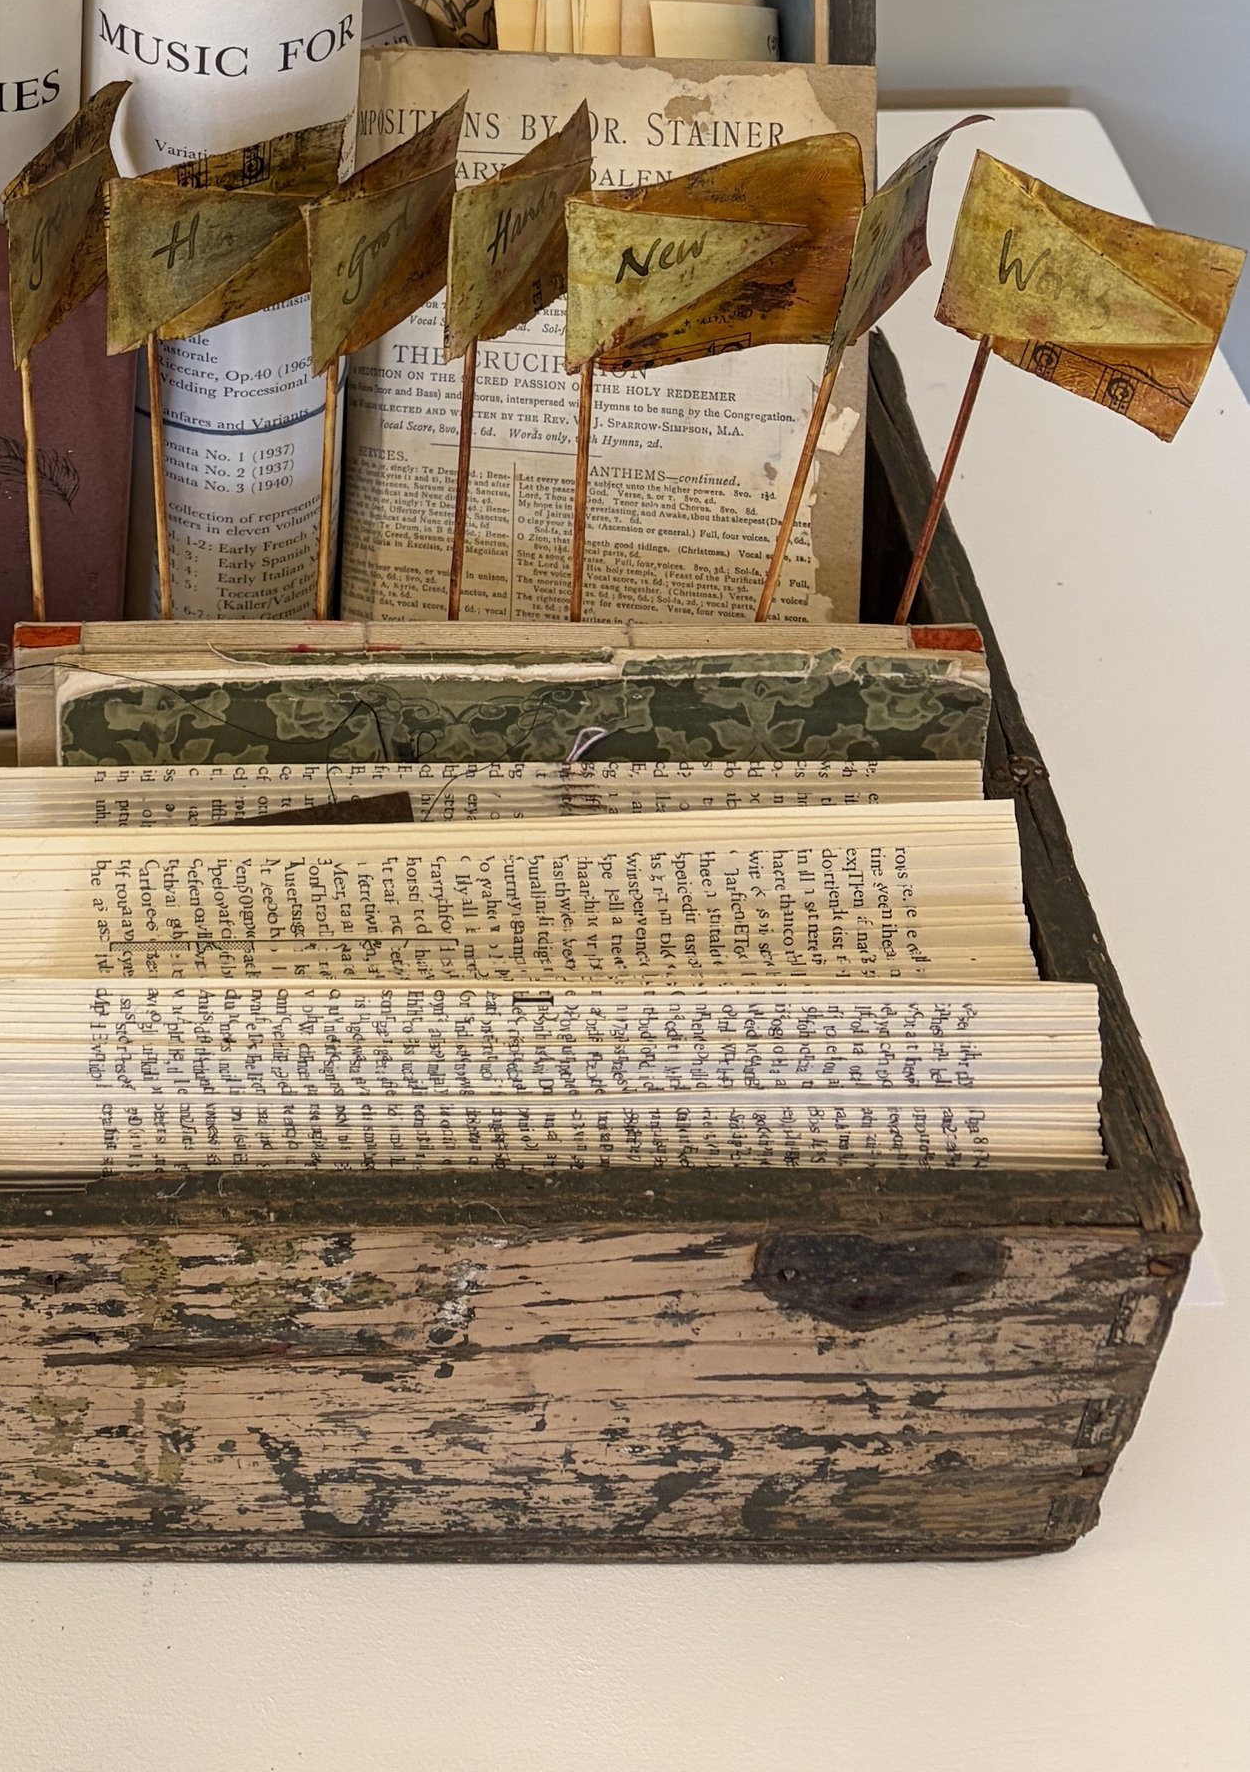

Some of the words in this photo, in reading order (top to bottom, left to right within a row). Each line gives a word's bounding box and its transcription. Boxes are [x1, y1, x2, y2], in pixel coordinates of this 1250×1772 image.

[98, 7, 249, 78] MUSIC
[278, 13, 354, 73] FOR
[359, 108, 500, 140] MPOSITINS
[522, 112, 557, 142] BY
[647, 111, 785, 148] STAINER
[154, 139, 212, 159] Variati
[454, 161, 506, 180] ARY
[486, 188, 559, 266] Hands
[342, 198, 411, 306] Good
[615, 230, 707, 284] New
[410, 315, 437, 327] Vocal
[392, 344, 447, 366] THE
[224, 374, 308, 398] Processional
[225, 368, 271, 385] Op.40
[407, 371, 424, 381] ON
[430, 372, 456, 383] THE
[515, 378, 566, 391] PASSION
[594, 384, 620, 394] THE
[626, 385, 661, 397] HOLY
[667, 388, 736, 402] REDEEMER
[395, 387, 412, 397] and
[416, 387, 441, 400] Bass)
[445, 391, 461, 400] and
[506, 394, 564, 408] interspersed
[594, 401, 630, 416] Hymns
[633, 403, 643, 412] to
[647, 403, 658, 413] be
[661, 407, 684, 418] sung
[688, 407, 701, 418] by
[704, 407, 720, 417] the
[723, 409, 796, 423] Congregation.
[163, 407, 211, 428] anfares
[217, 420, 244, 431] and
[252, 407, 309, 429] Variants
[426, 407, 446, 416] AND
[501, 412, 514, 421] BY
[517, 414, 539, 423] THE
[593, 417, 603, 428] J.
[717, 425, 744, 437] M.A.
[406, 421, 435, 434] Score,
[439, 423, 459, 435] 8vo,
[480, 427, 496, 437] 6d.
[509, 428, 542, 441] Words
[546, 433, 571, 444] only,
[601, 435, 643, 448] Hymns,
[647, 439, 663, 449] 2d.
[163, 441, 199, 457] onata
[205, 448, 231, 462] No.
[252, 443, 295, 463] (1937)
[163, 456, 198, 472] onata
[205, 464, 230, 478] No.
[237, 468, 245, 478] 2
[252, 459, 294, 479] (1937)
[164, 470, 198, 487] onata
[204, 480, 229, 493] No.
[236, 483, 245, 493] 3
[251, 475, 294, 495] (1940)
[519, 474, 534, 483] Let
[537, 477, 559, 486] every
[594, 480, 623, 490] subject
[626, 483, 645, 491] unto
[647, 483, 661, 492] the
[664, 485, 691, 495] higher
[693, 487, 726, 497] powers.
[169, 501, 233, 524] collection
[239, 512, 253, 524] of
[207, 523, 220, 534] in
[226, 526, 270, 536] eleven
[276, 507, 321, 530] volume
[187, 536, 212, 551] 1-2:
[219, 543, 257, 556] Early
[263, 531, 307, 552] French
[465, 545, 509, 557] Magnificat
[614, 542, 634, 551] good
[185, 550, 198, 562] 3:
[218, 557, 256, 571] Early
[261, 545, 310, 568] Spanish
[218, 572, 255, 585] Early
[262, 563, 304, 582] Italian
[216, 587, 278, 599] Toccatas
[283, 576, 296, 592] of
